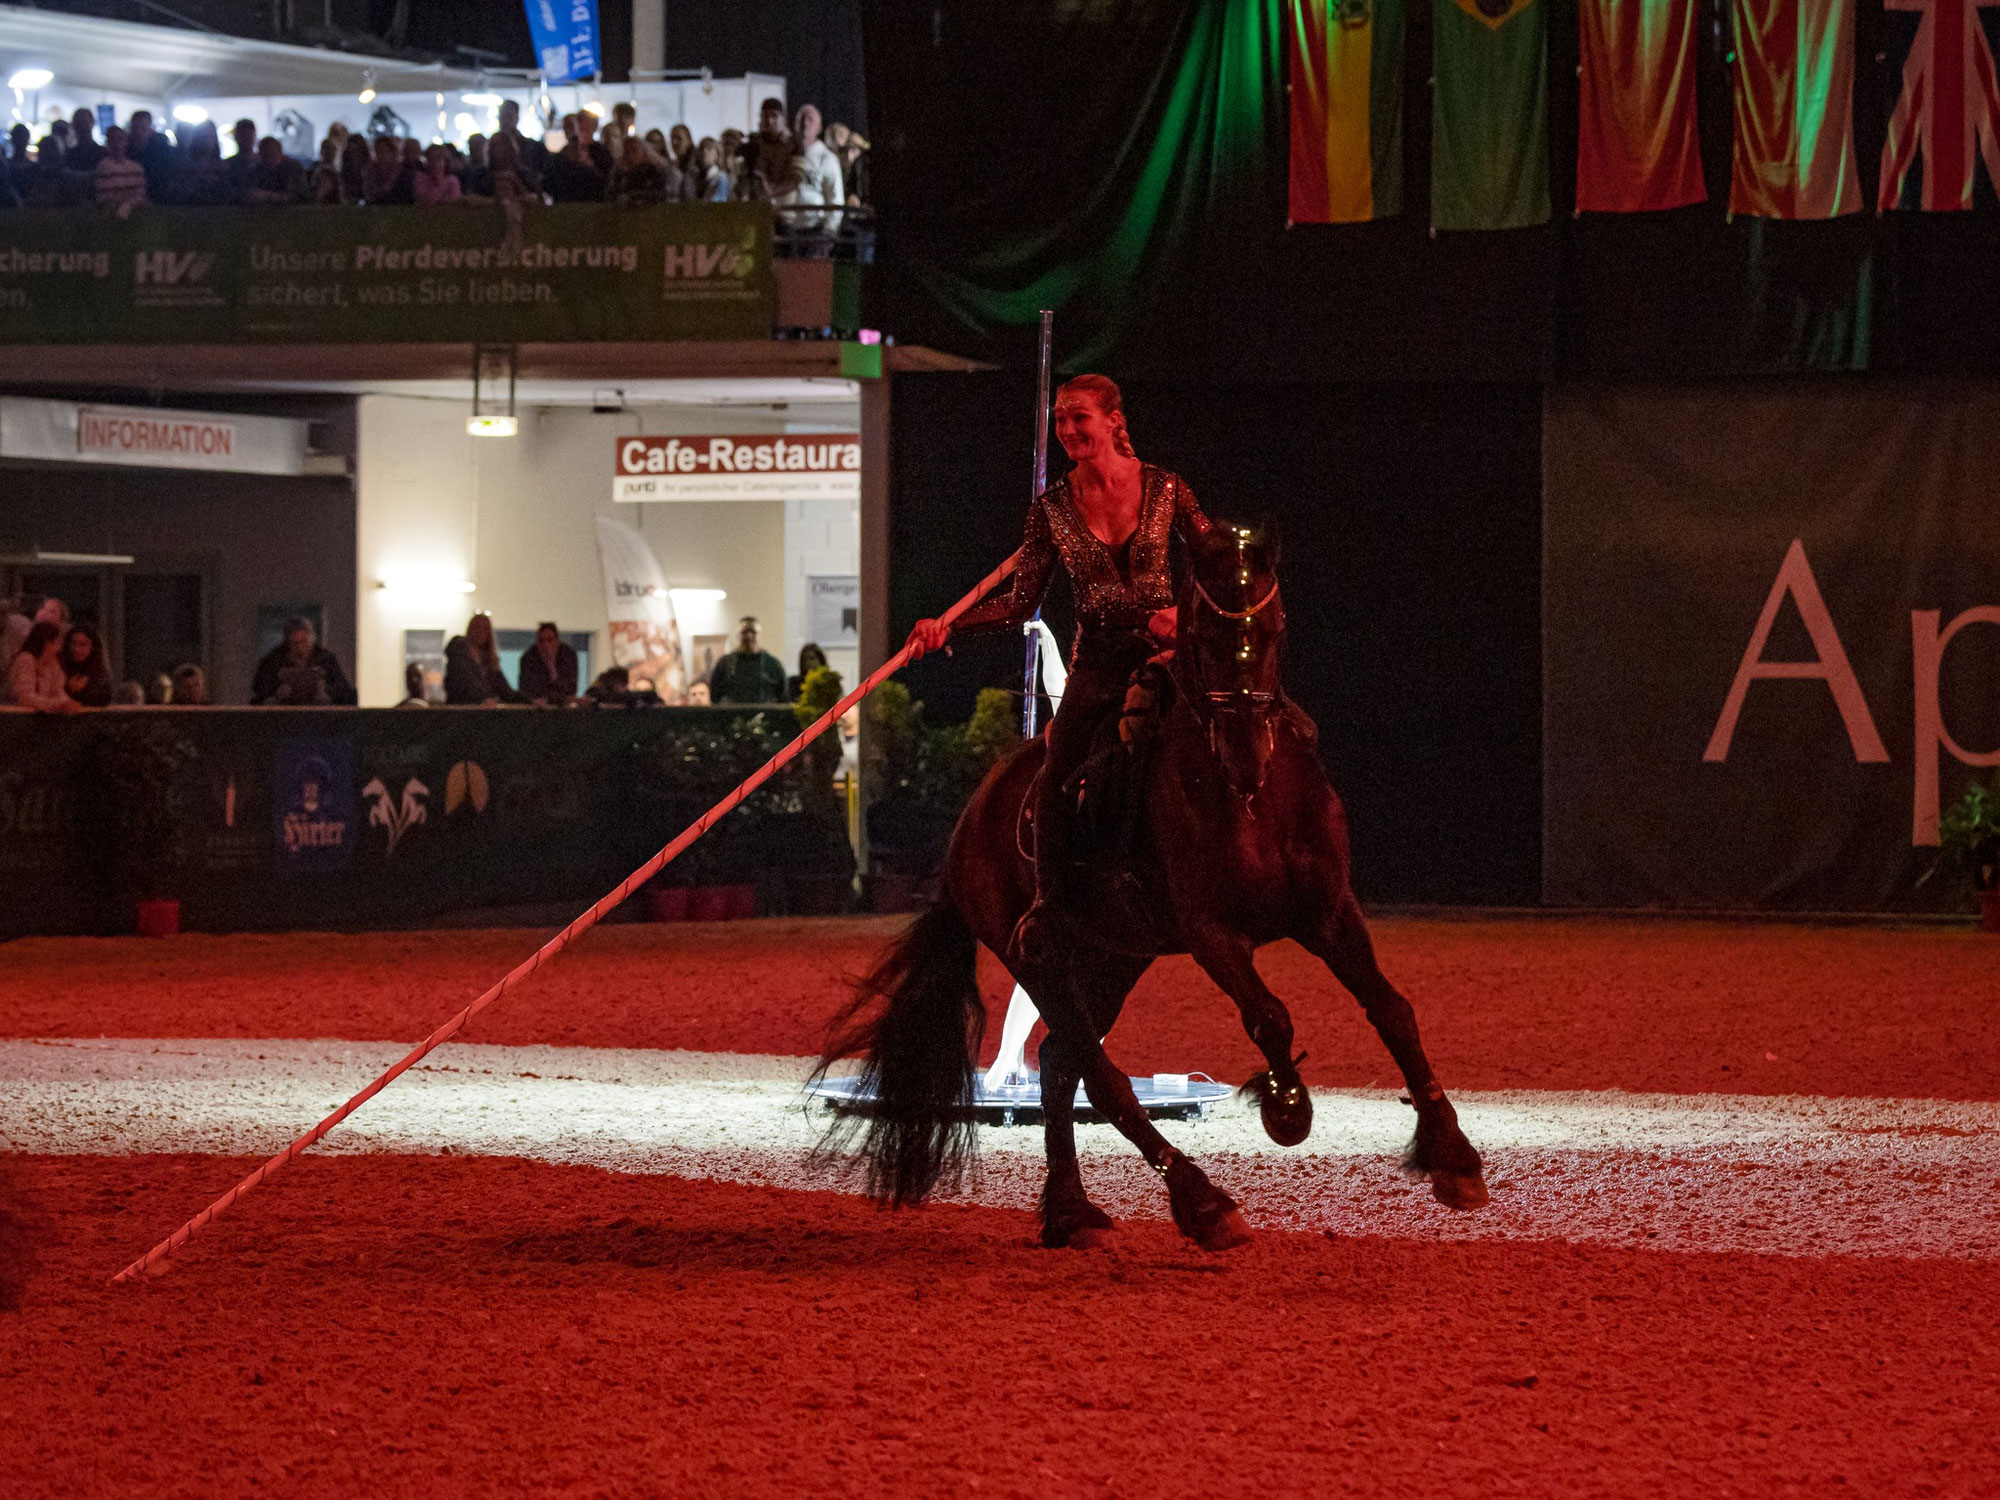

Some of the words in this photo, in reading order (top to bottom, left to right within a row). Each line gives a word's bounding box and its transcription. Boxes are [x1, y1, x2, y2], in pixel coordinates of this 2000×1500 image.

[250, 245, 347, 271] Unsere
[357, 285, 411, 305] was
[418, 277, 460, 305] Sie
[84, 417, 233, 456] INFORMATION
[1702, 538, 2000, 847] Ap
